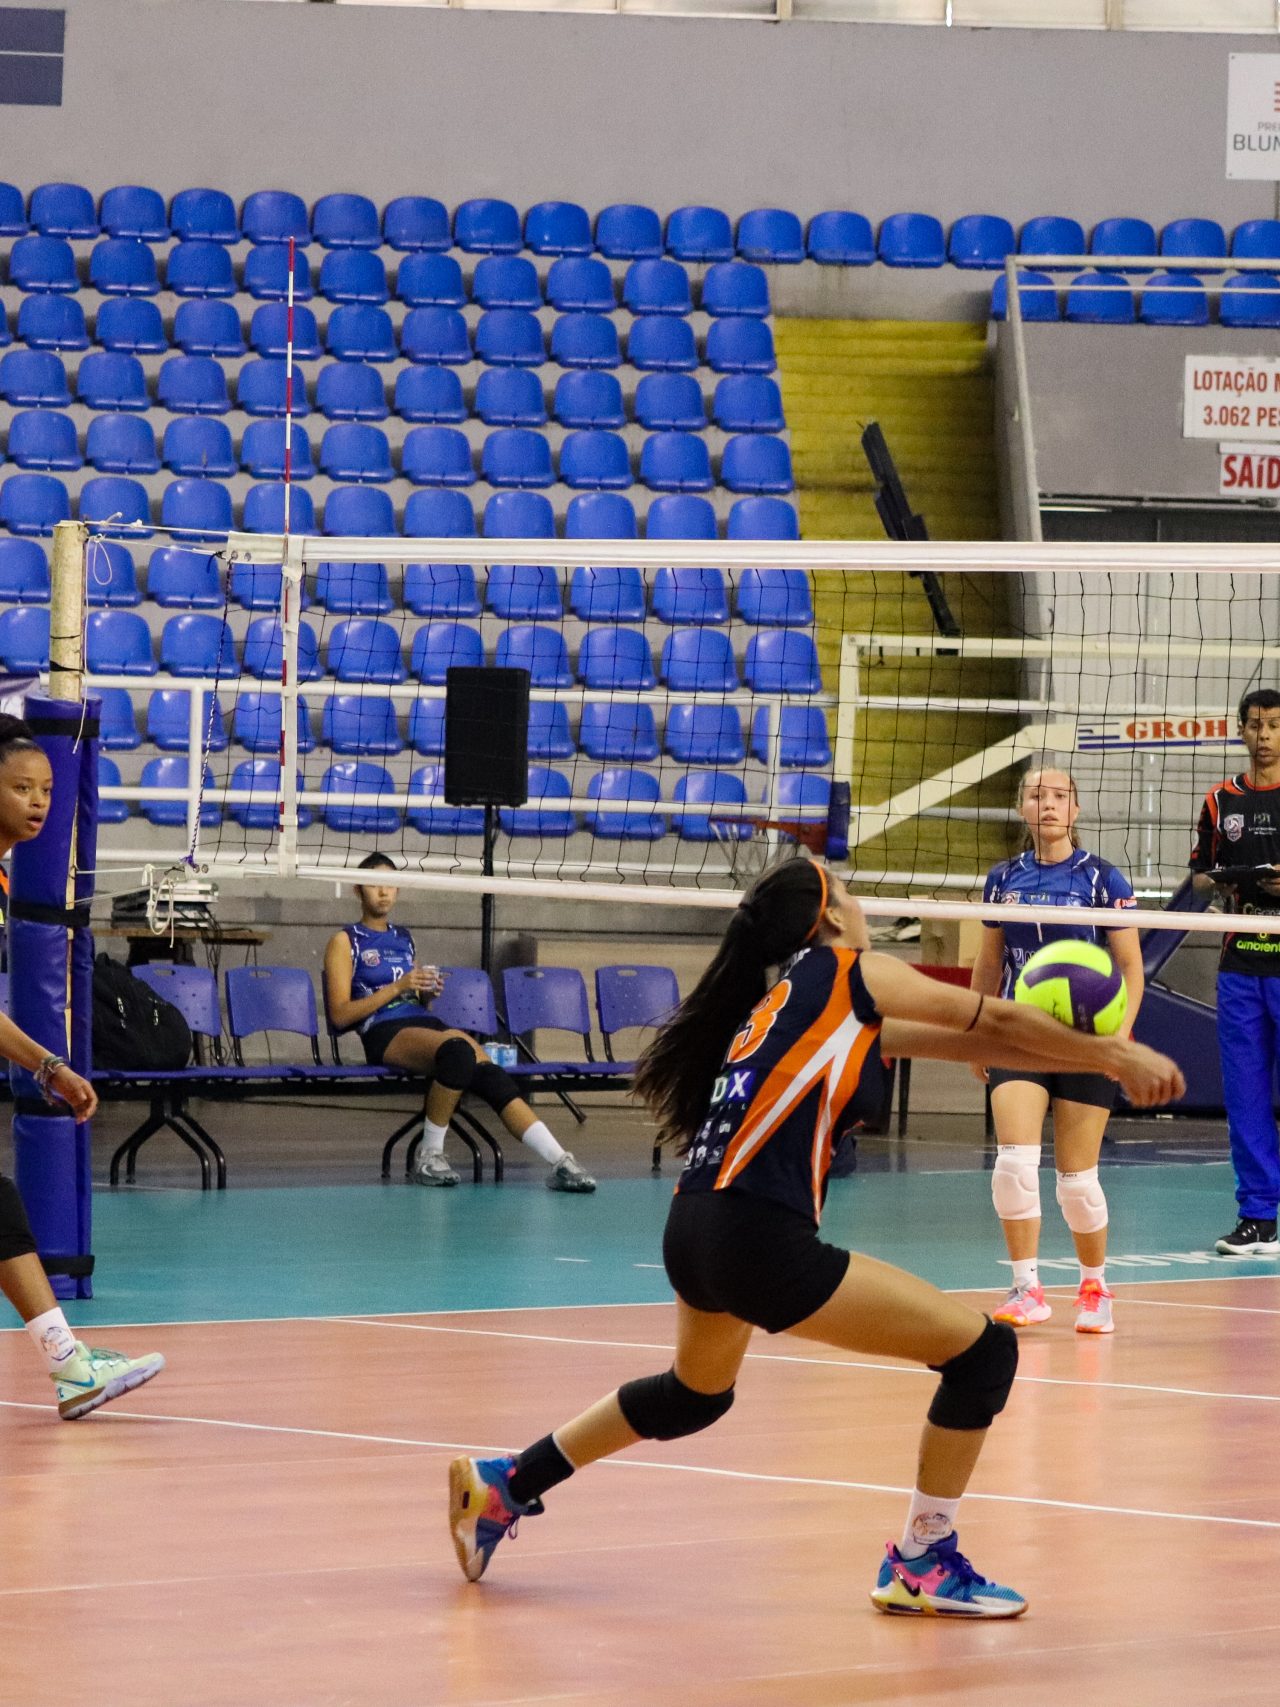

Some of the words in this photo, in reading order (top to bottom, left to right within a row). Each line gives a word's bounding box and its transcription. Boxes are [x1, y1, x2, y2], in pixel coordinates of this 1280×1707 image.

[1193, 366, 1268, 398] LOTAÇÃO
[1203, 405, 1250, 427] 3.062
[1126, 719, 1228, 740] GROH
